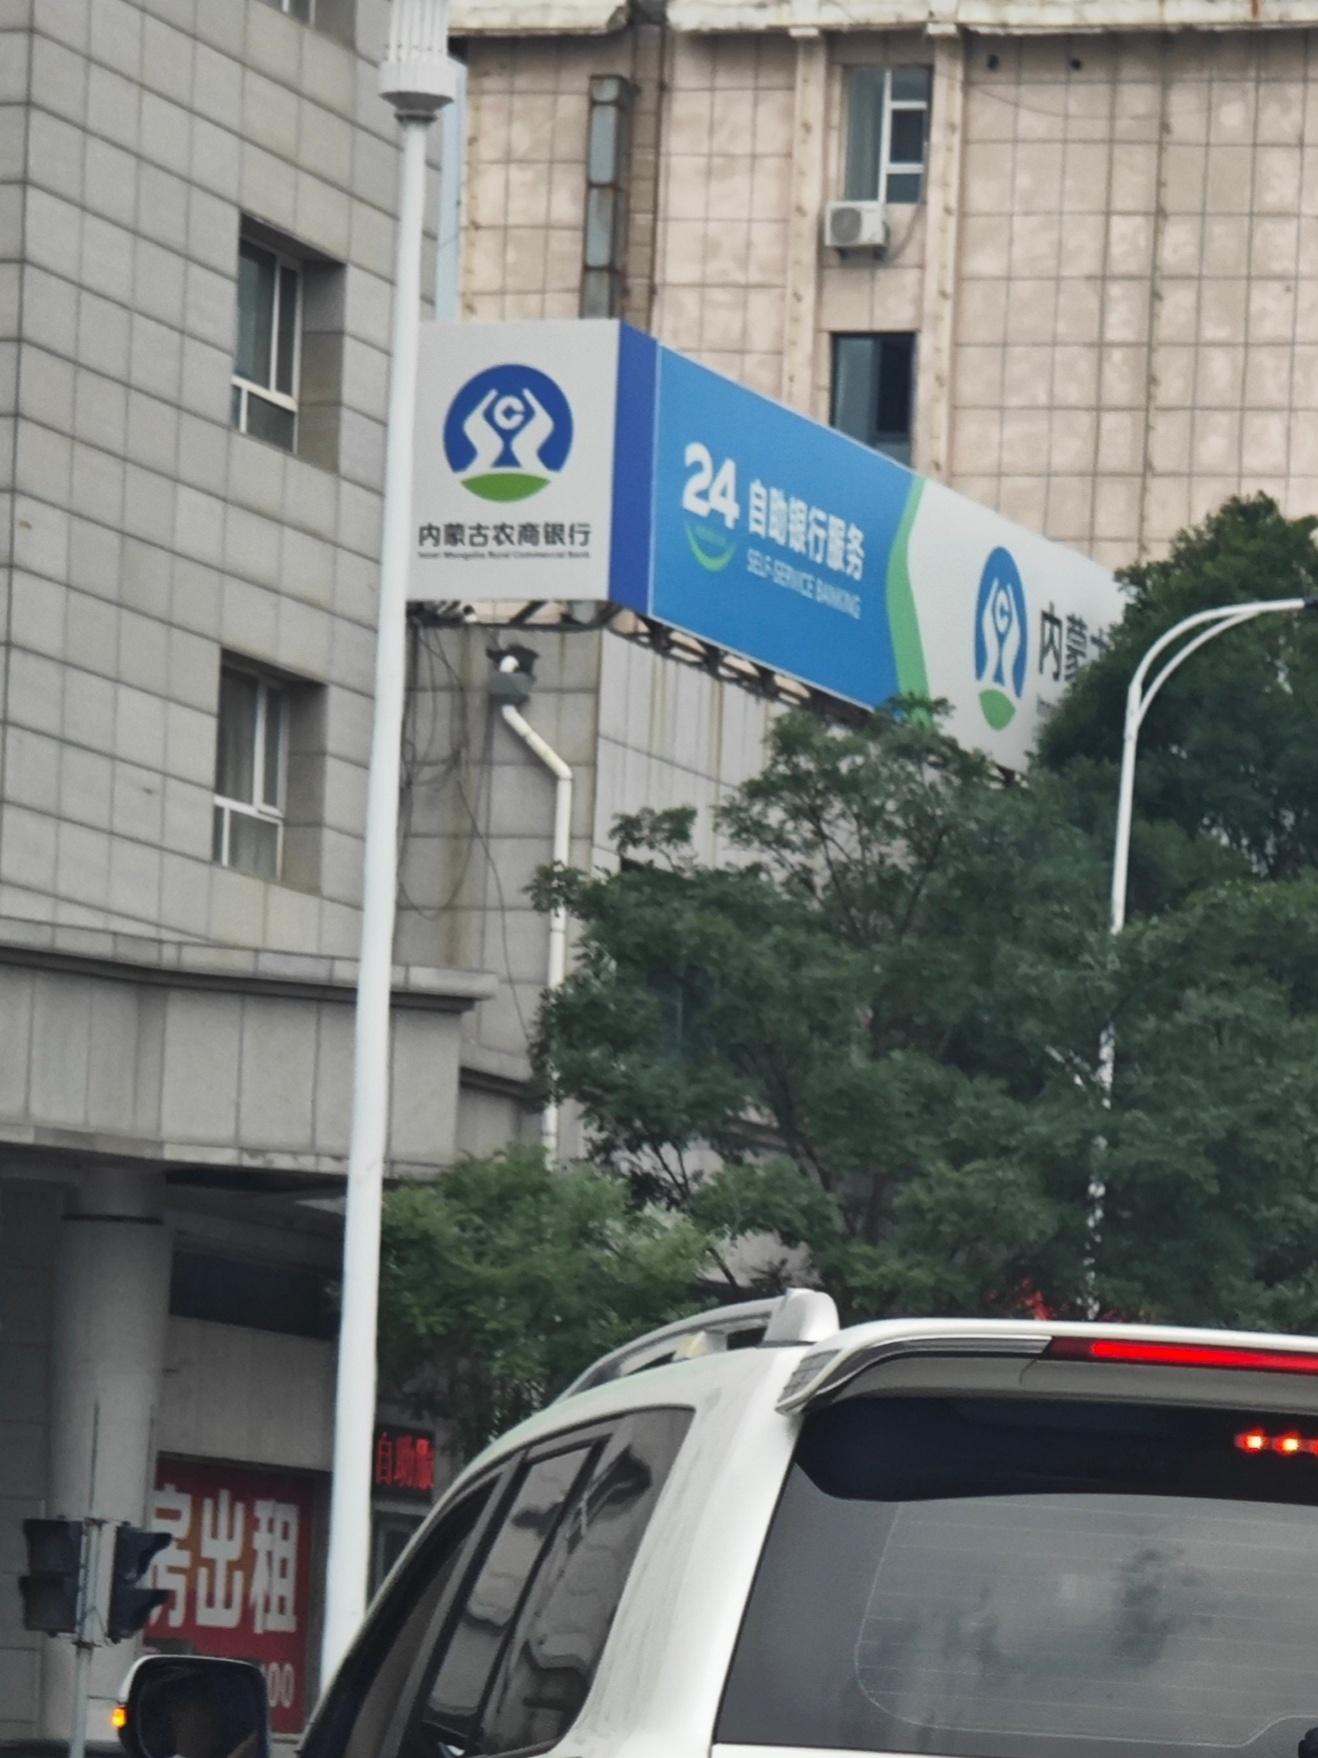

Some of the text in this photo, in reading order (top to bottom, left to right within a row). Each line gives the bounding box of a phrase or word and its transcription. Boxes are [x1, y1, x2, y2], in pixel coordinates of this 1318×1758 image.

[682, 441, 740, 530] 24
[750, 478, 865, 581] 自助银行服务
[418, 522, 592, 548] 内蒙古农商银行
